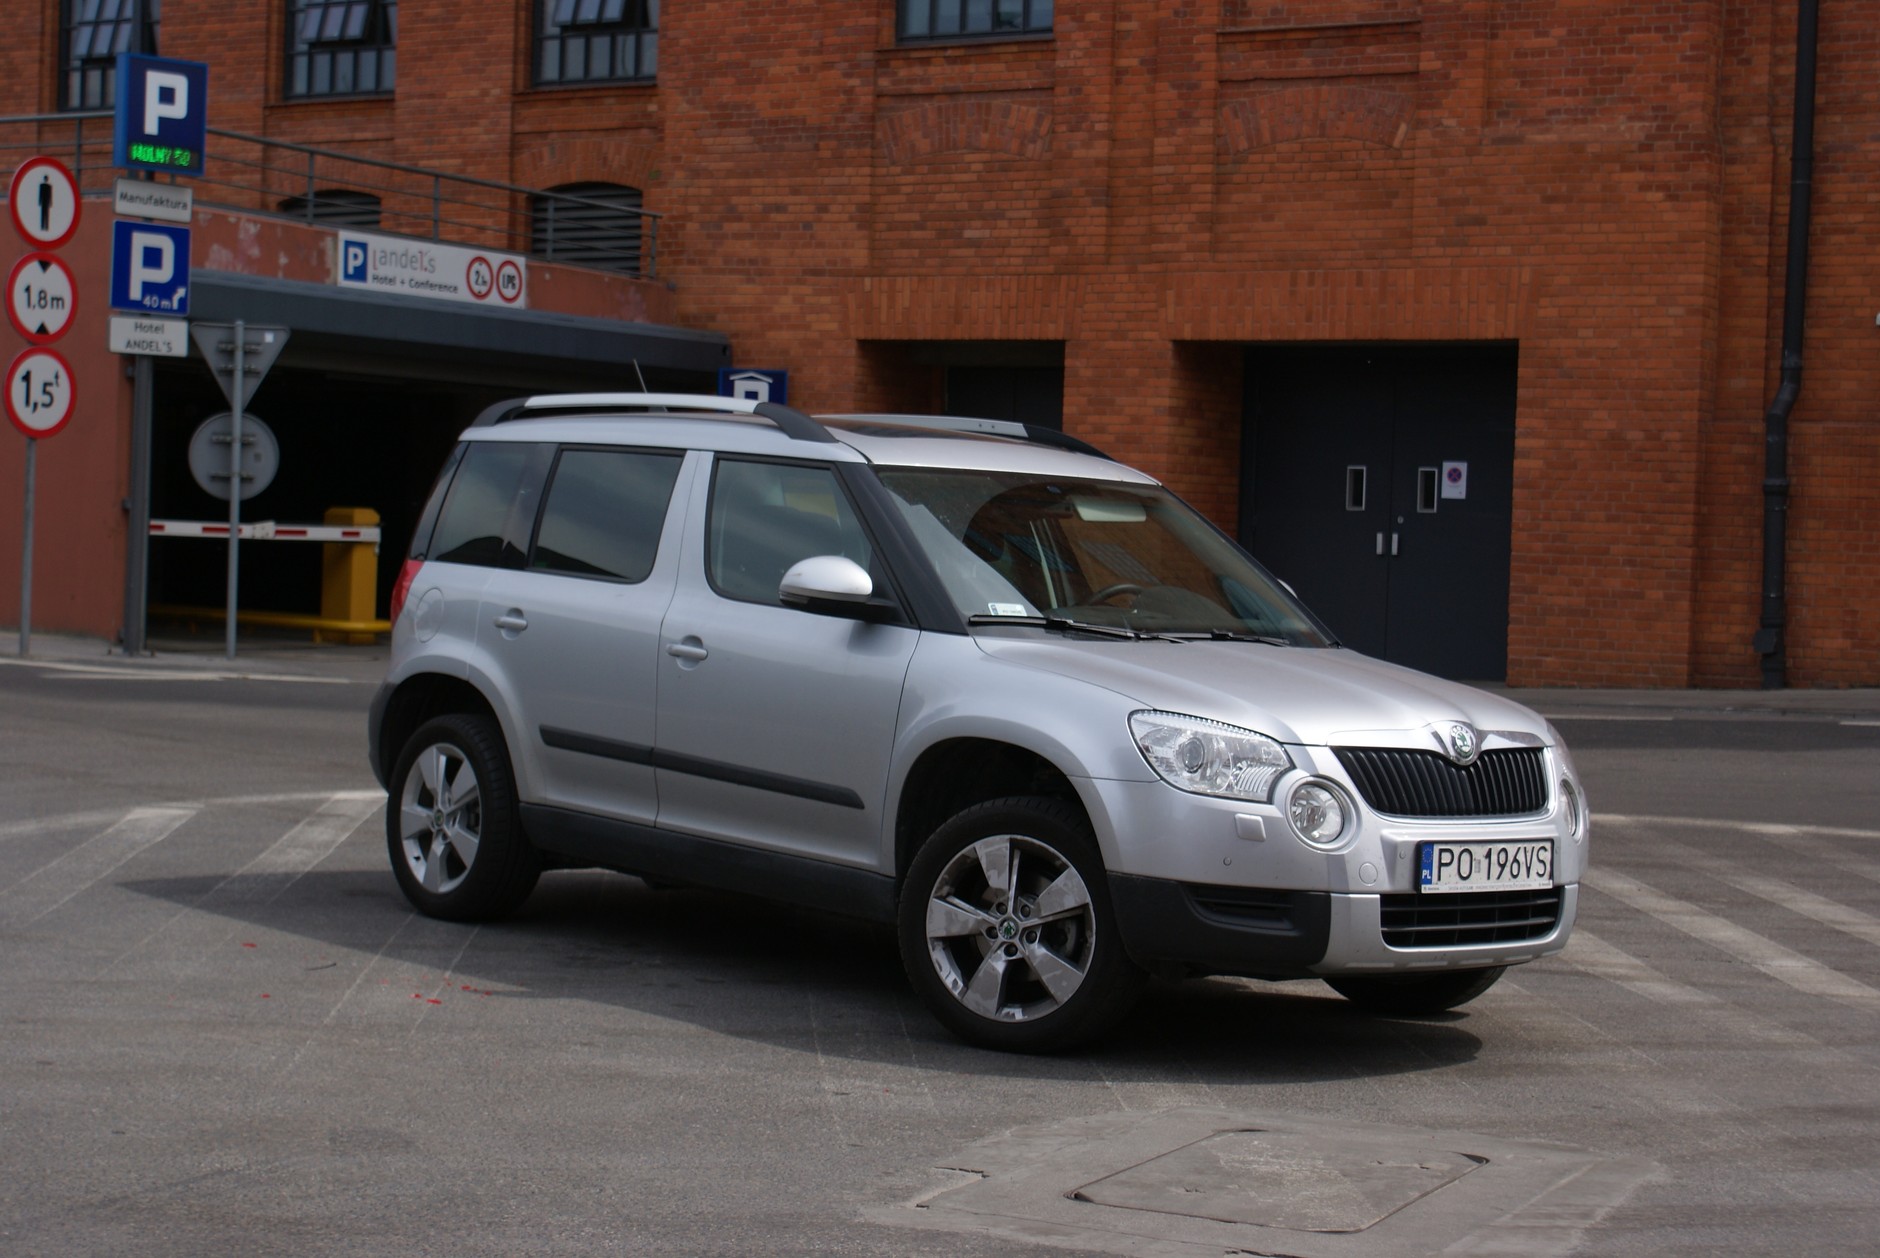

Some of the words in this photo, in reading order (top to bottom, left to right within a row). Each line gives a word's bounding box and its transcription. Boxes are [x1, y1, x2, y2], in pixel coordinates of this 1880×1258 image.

[144, 70, 189, 136] P
[119, 191, 188, 211] Manufaktura
[129, 231, 175, 300] P
[347, 246, 365, 275] P
[372, 274, 396, 286] Hotel
[408, 278, 459, 294] Conference
[134, 321, 165, 334] Hotel
[1422, 869, 1432, 880] PL
[1437, 848, 1474, 882] PO
[1483, 845, 1549, 881] 196VS
